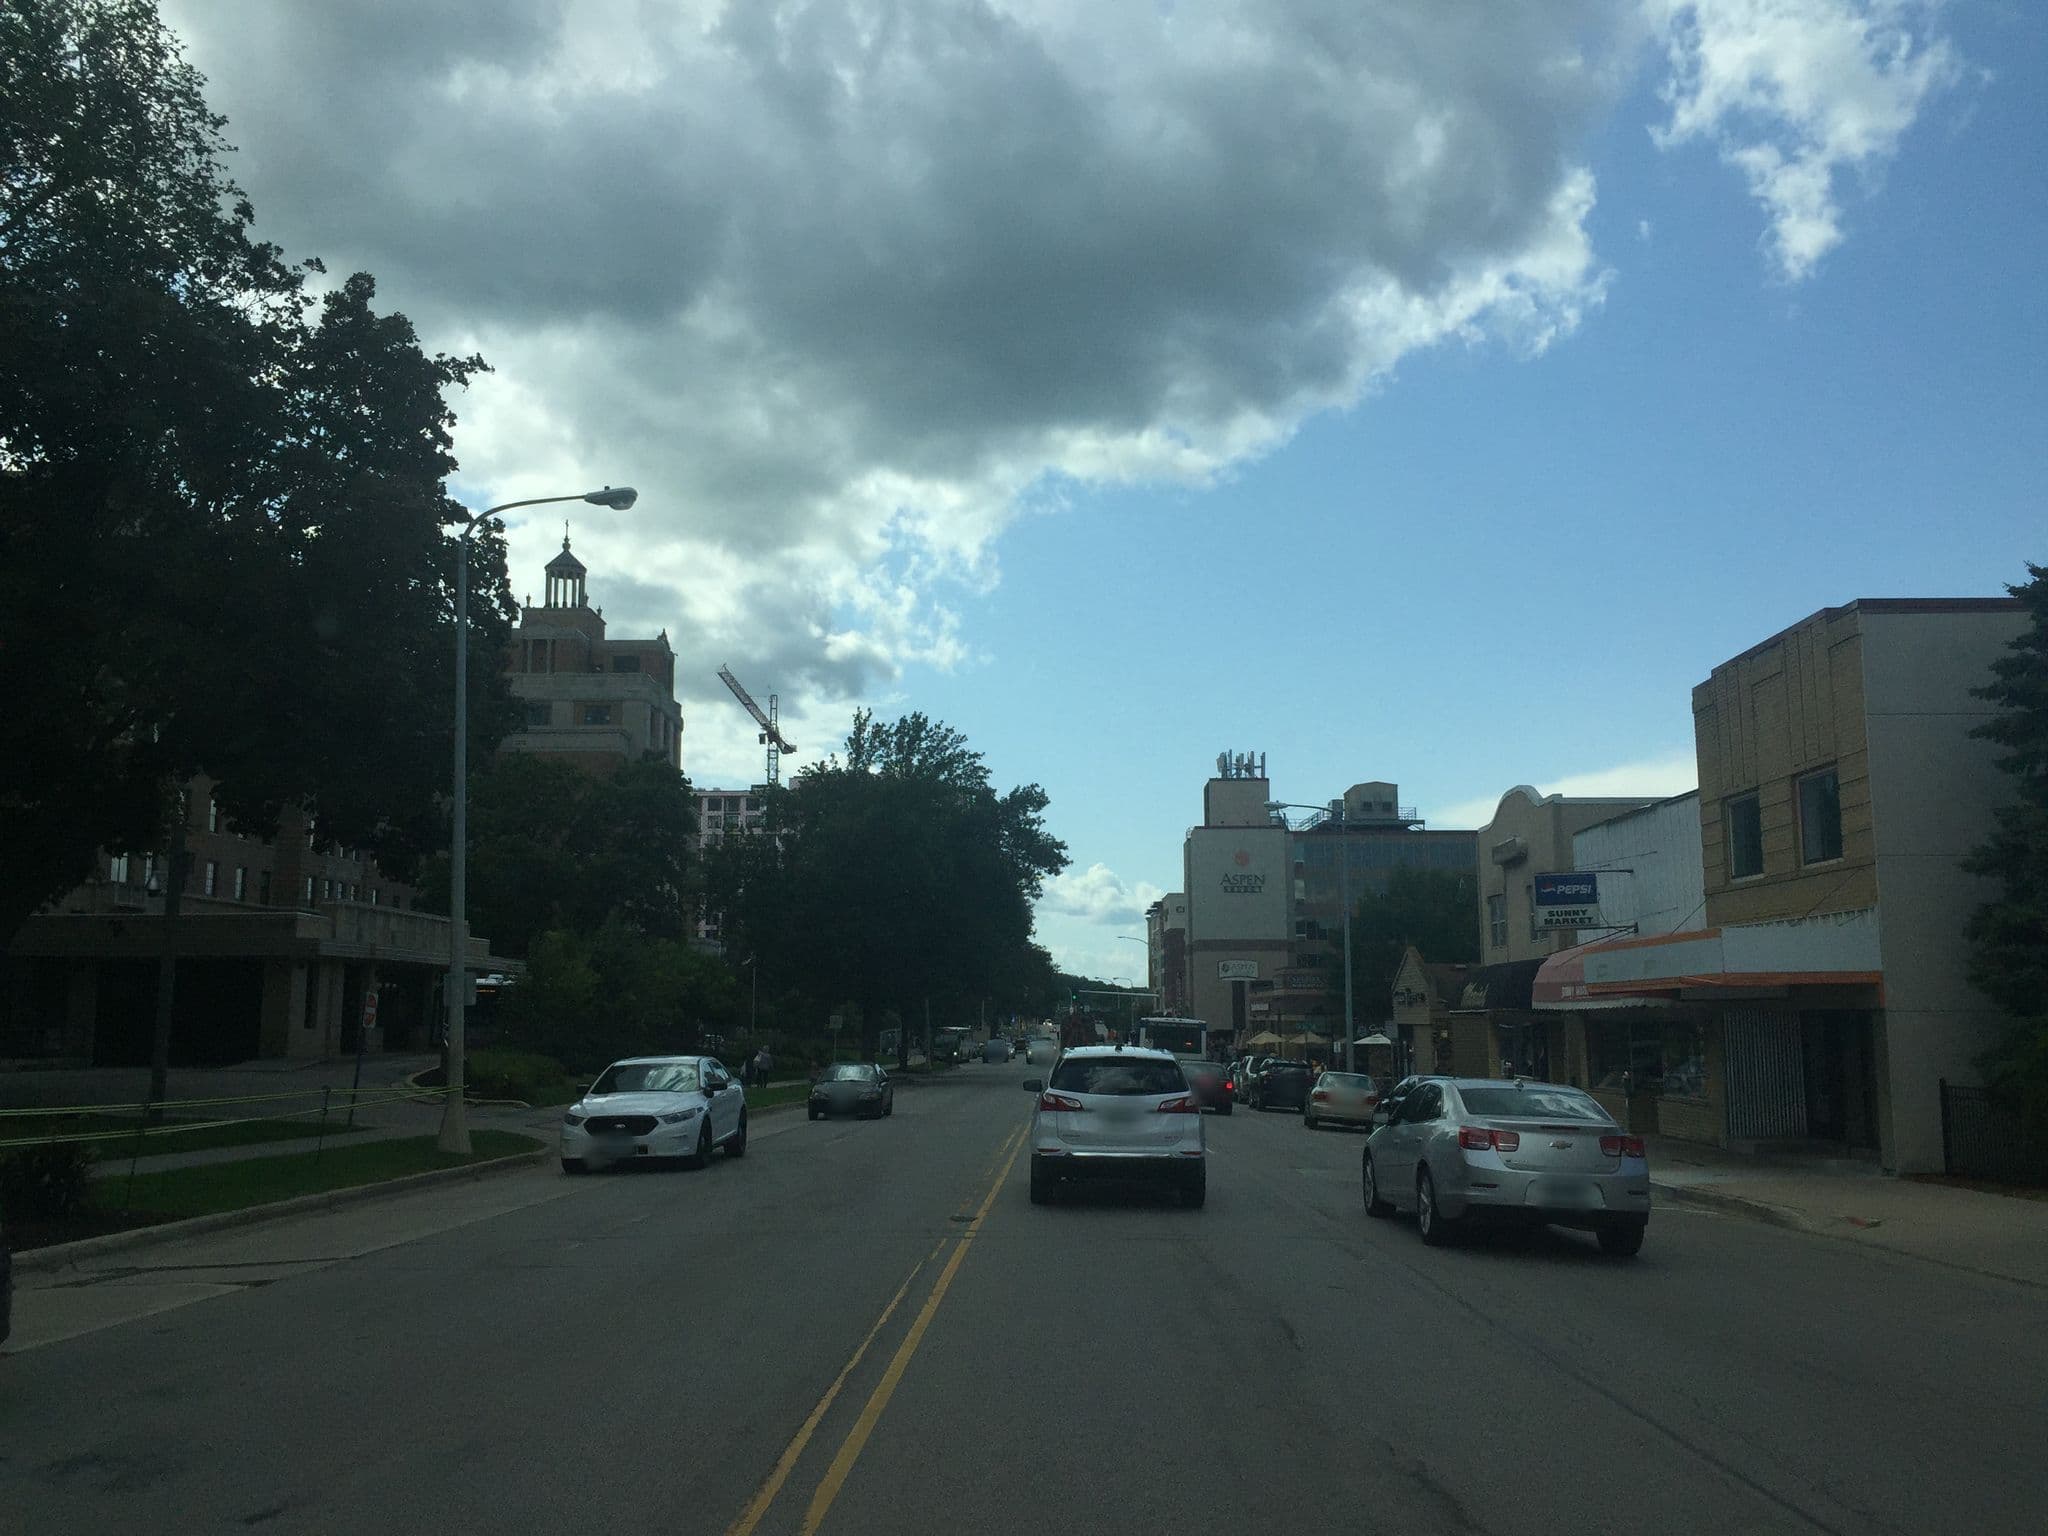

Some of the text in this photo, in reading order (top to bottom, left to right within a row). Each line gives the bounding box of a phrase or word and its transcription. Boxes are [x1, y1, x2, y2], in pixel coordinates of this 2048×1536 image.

[1220, 873, 1265, 885] ASPEN
[1557, 884, 1592, 894] PEPSI
[1547, 909, 1588, 917] SUNNY
[1544, 917, 1593, 925] MARKET
